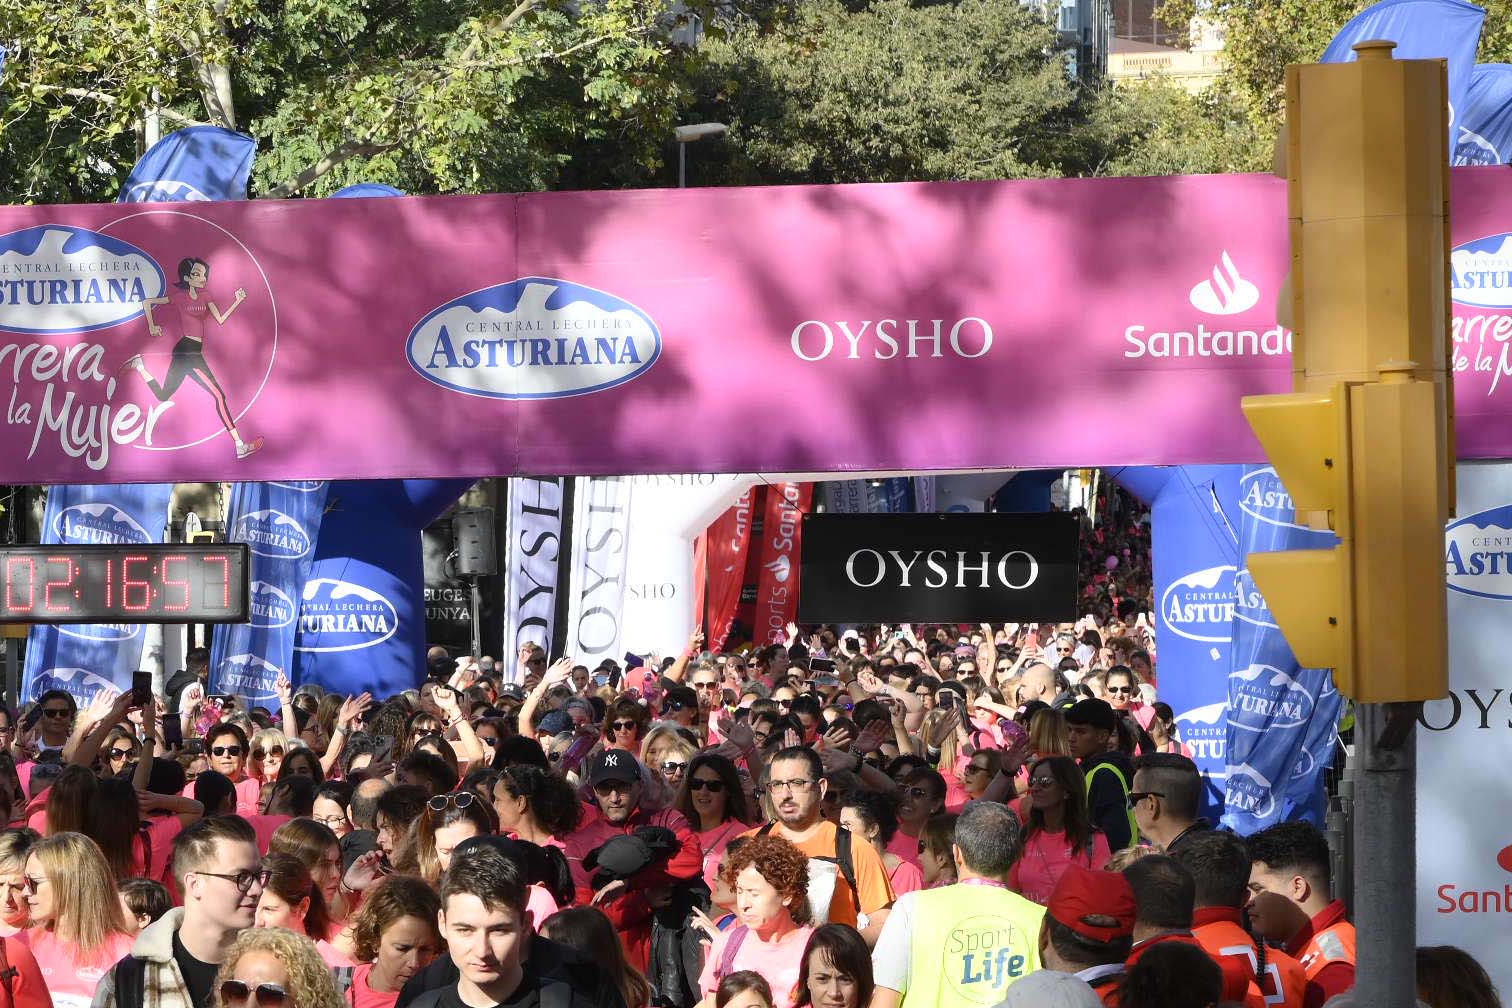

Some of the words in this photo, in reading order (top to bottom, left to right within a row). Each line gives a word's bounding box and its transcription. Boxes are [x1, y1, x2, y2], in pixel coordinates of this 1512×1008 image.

[67, 260, 142, 273] LECHERA
[465, 320, 544, 332] CENTRAL
[552, 318, 632, 331] LECHERA
[791, 317, 993, 361] OYSHO
[1452, 314, 1512, 343] arre
[425, 324, 642, 369] ASTURIANA
[1474, 343, 1493, 372] la
[6, 384, 32, 425] la
[26, 373, 175, 470] Mujer
[59, 514, 144, 544] ASTURIA
[239, 522, 303, 554] ASTURIANA
[5, 554, 232, 612] 02:16:57
[845, 548, 1039, 590] OYSHO
[630, 582, 676, 600] SHO
[334, 603, 385, 612] LECHERA
[1187, 728, 1227, 737] CENTRA
[950, 923, 1015, 956] Sport
[960, 947, 1025, 989] Life
